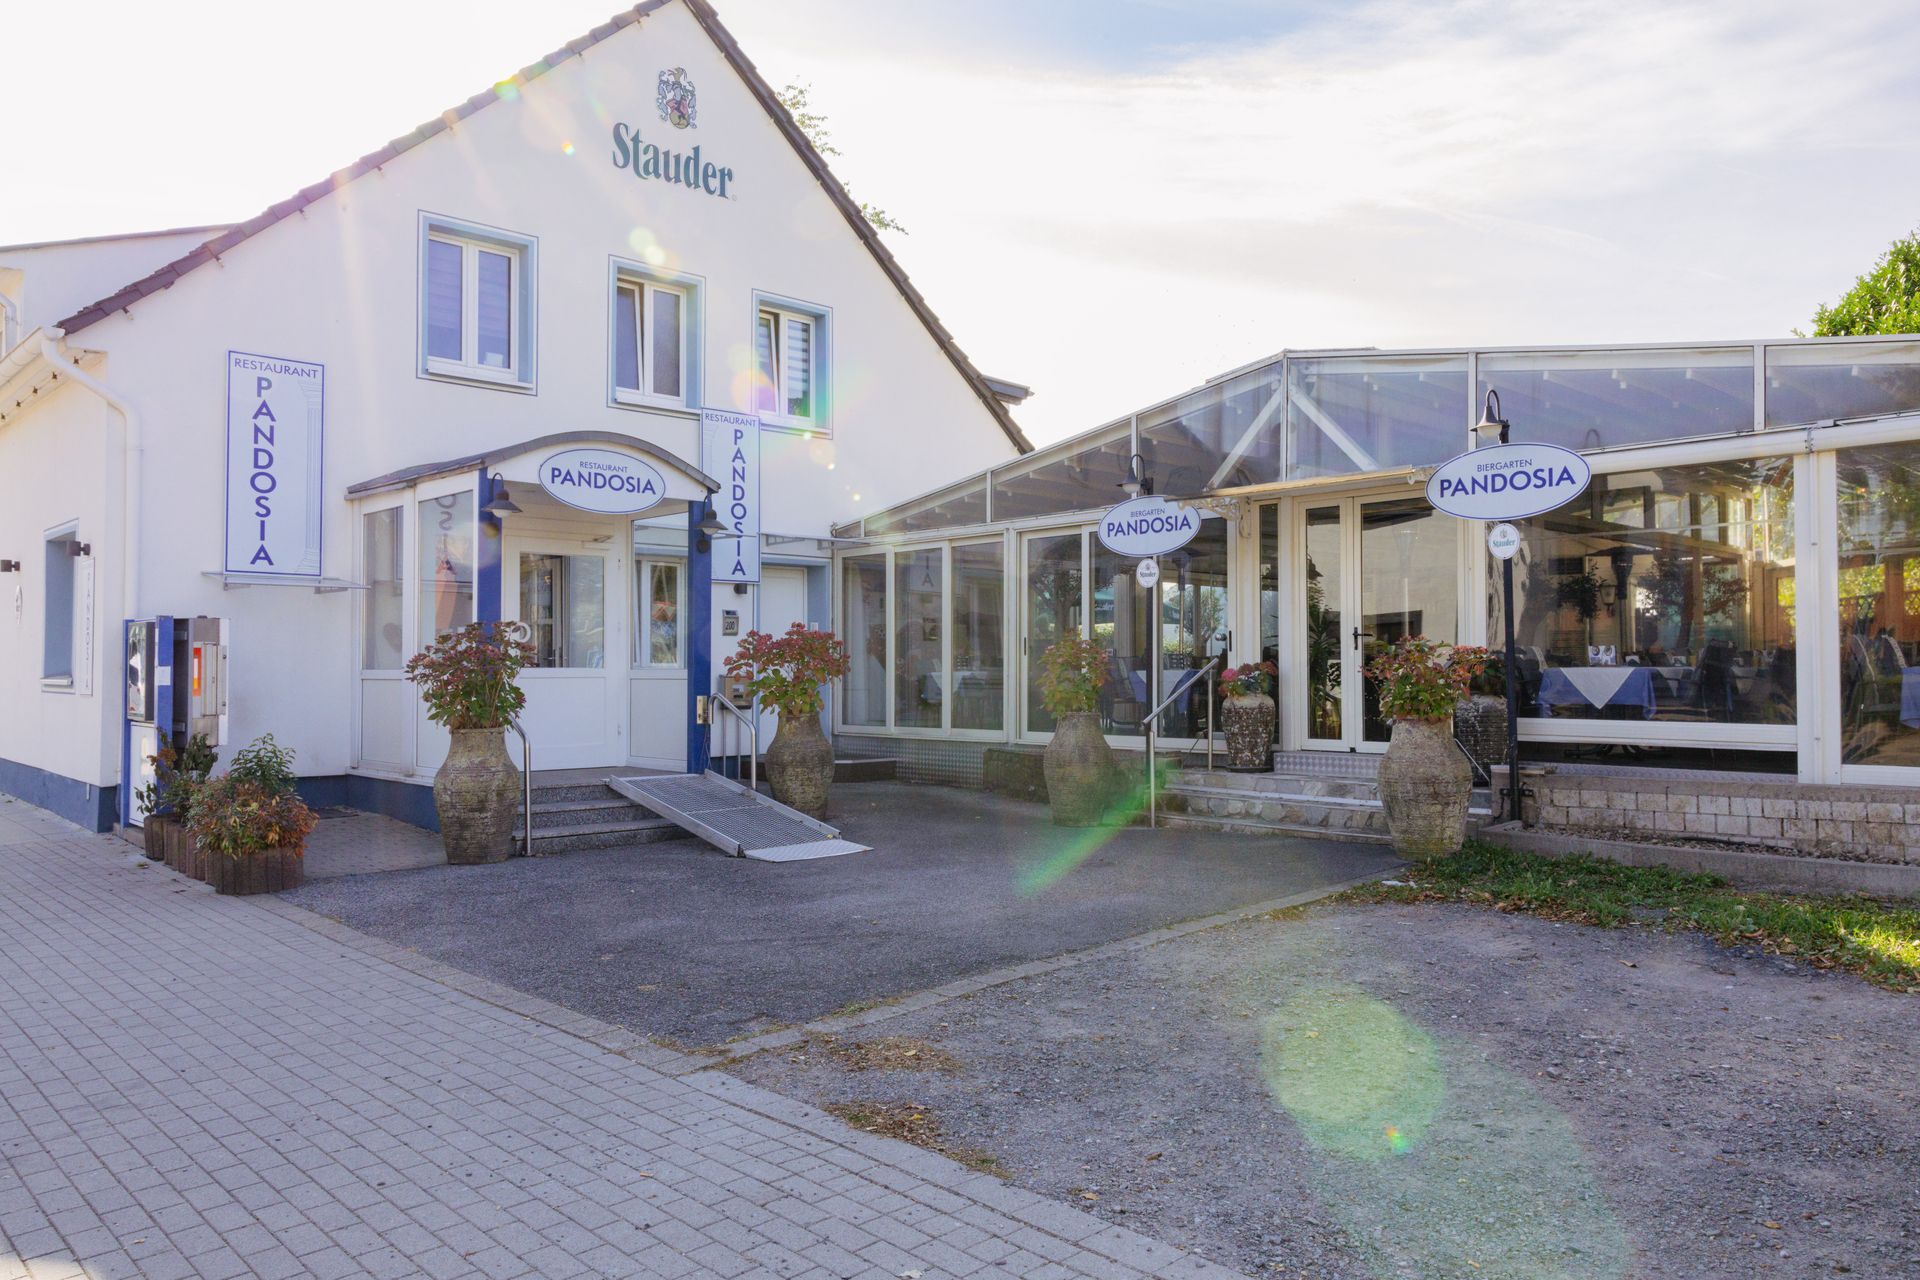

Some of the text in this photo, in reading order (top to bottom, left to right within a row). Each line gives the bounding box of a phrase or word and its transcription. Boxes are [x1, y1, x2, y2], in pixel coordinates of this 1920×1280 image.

[612, 122, 733, 199] Stauder
[234, 357, 319, 379] RESTAURANT
[705, 412, 756, 427] RESTAURANT
[249, 376, 277, 566] PANDOSIA
[579, 460, 628, 473] RESTAURANT
[1476, 458, 1533, 473] BIERGARTEN
[550, 466, 657, 495] PANDOSIA
[1439, 465, 1577, 498] PANDOSIA
[730, 428, 747, 576] PANDOSIA
[1130, 507, 1166, 518] BIERGARTEN
[1107, 514, 1192, 538] PANDOSIA
[1492, 537, 1516, 548] Stauder
